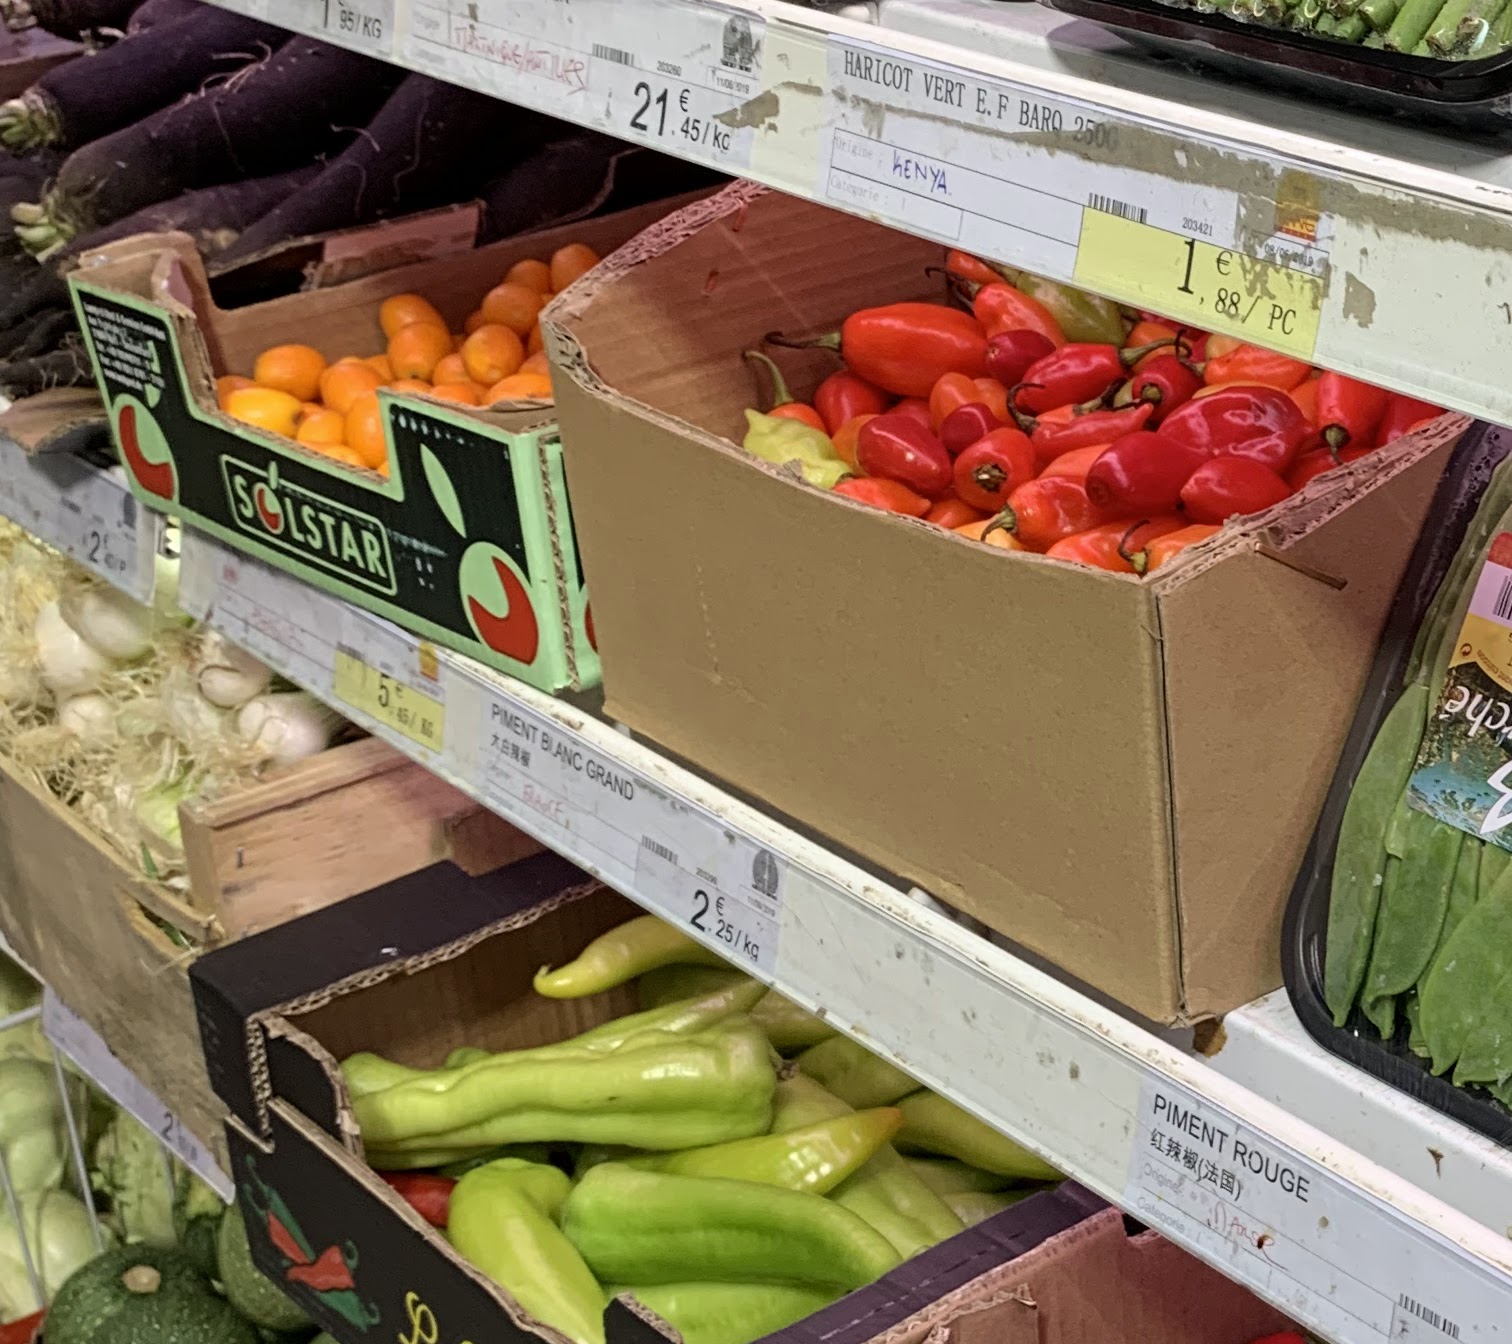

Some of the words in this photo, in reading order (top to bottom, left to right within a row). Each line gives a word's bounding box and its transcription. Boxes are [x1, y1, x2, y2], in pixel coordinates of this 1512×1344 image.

[843, 50, 913, 92] HARICOT
[923, 72, 966, 107] VERT
[1182, 217, 1214, 237] 203421
[233, 474, 388, 579] SOLSTAR
[491, 703, 538, 745] PIMENT
[541, 730, 583, 772] BLANC
[585, 757, 635, 801] GRAND
[1153, 1093, 1229, 1153] PIMENT
[1233, 1140, 1311, 1203] ROUGE
